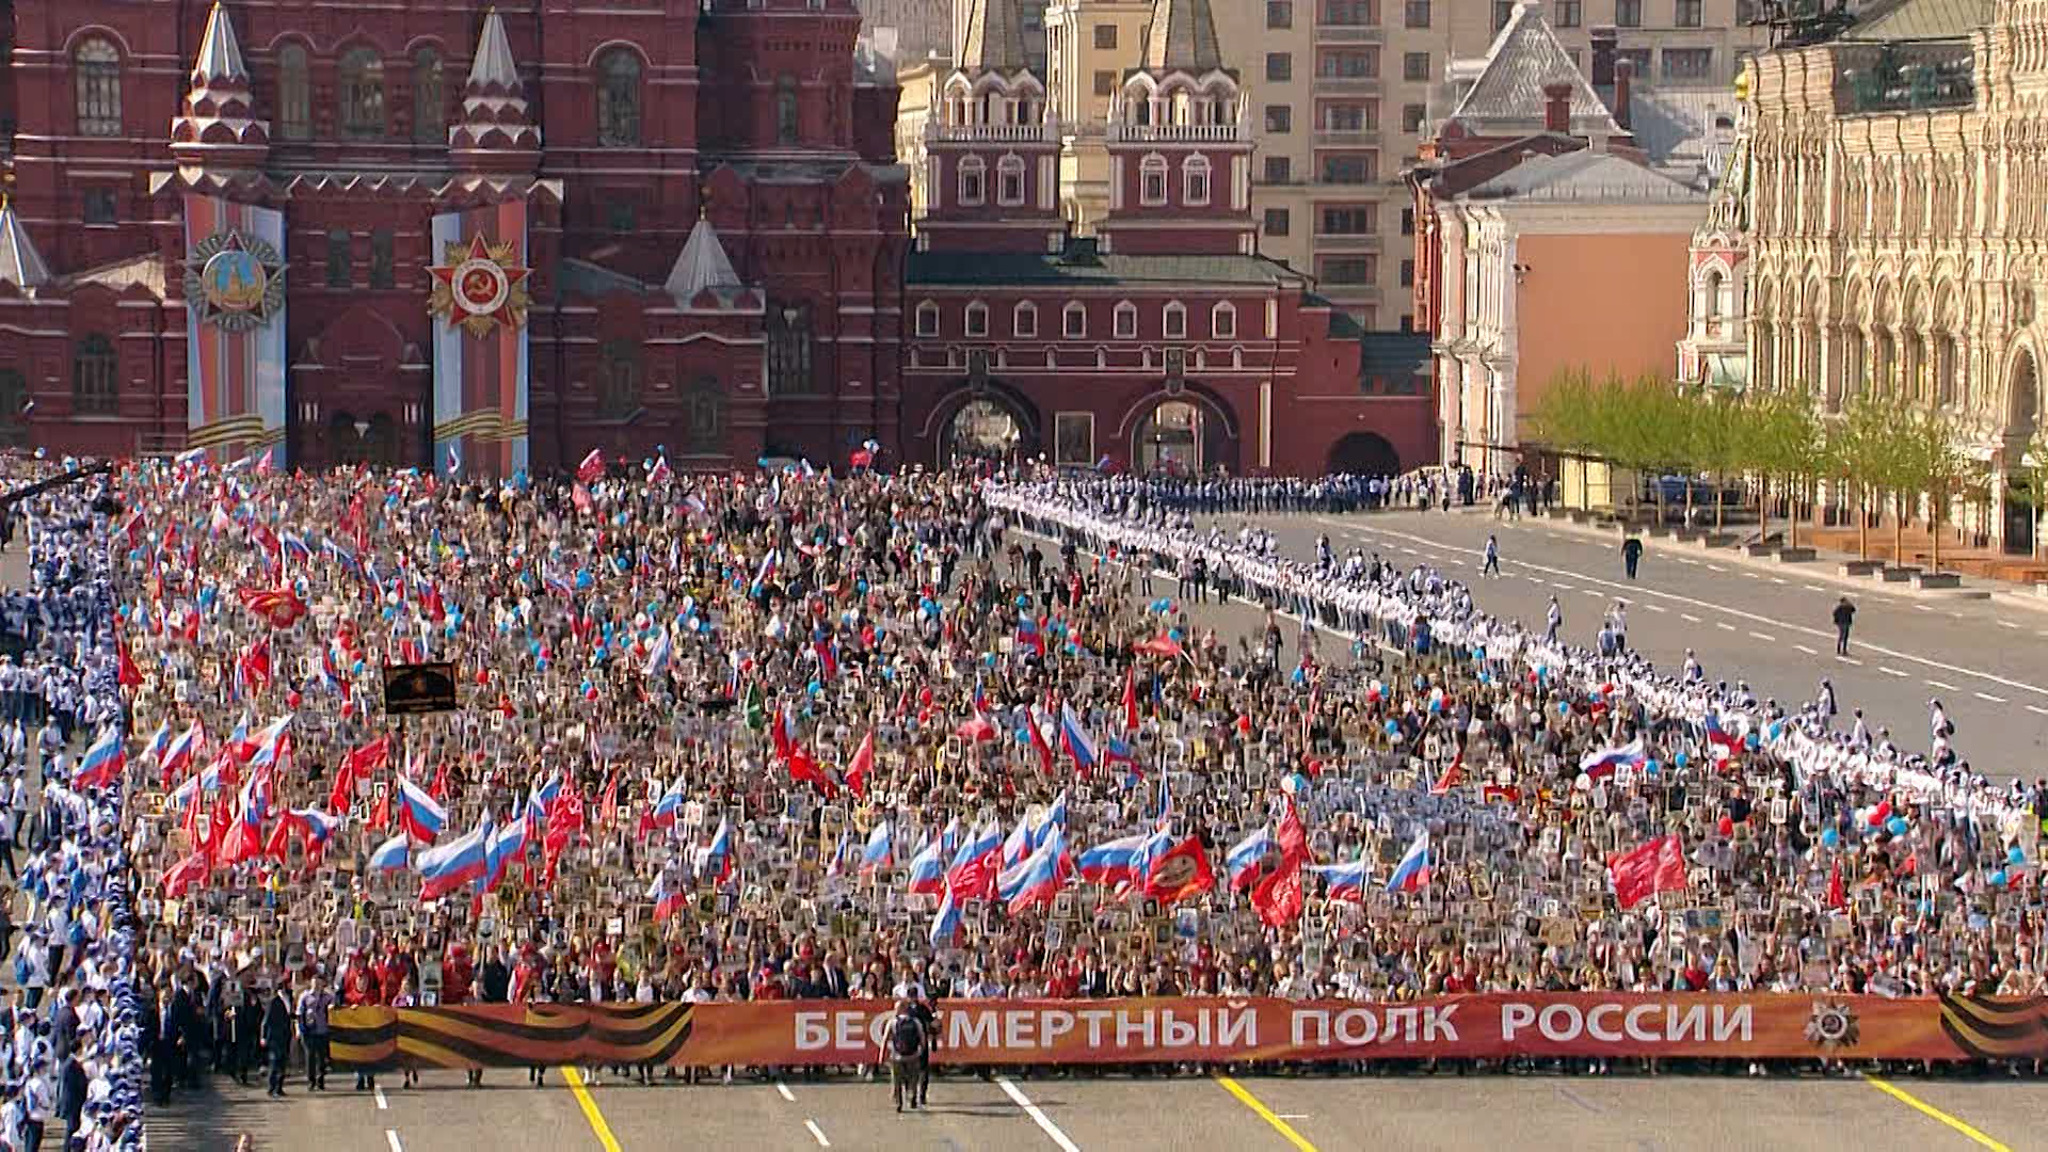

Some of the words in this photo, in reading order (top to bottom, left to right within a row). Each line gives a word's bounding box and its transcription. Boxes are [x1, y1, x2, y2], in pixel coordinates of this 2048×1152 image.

[793, 1000, 1258, 1051] БЕСМЕРТНЫЙ
[1290, 1003, 1460, 1047] ПОЛК
[1501, 1003, 1754, 1042] РОССИИ
